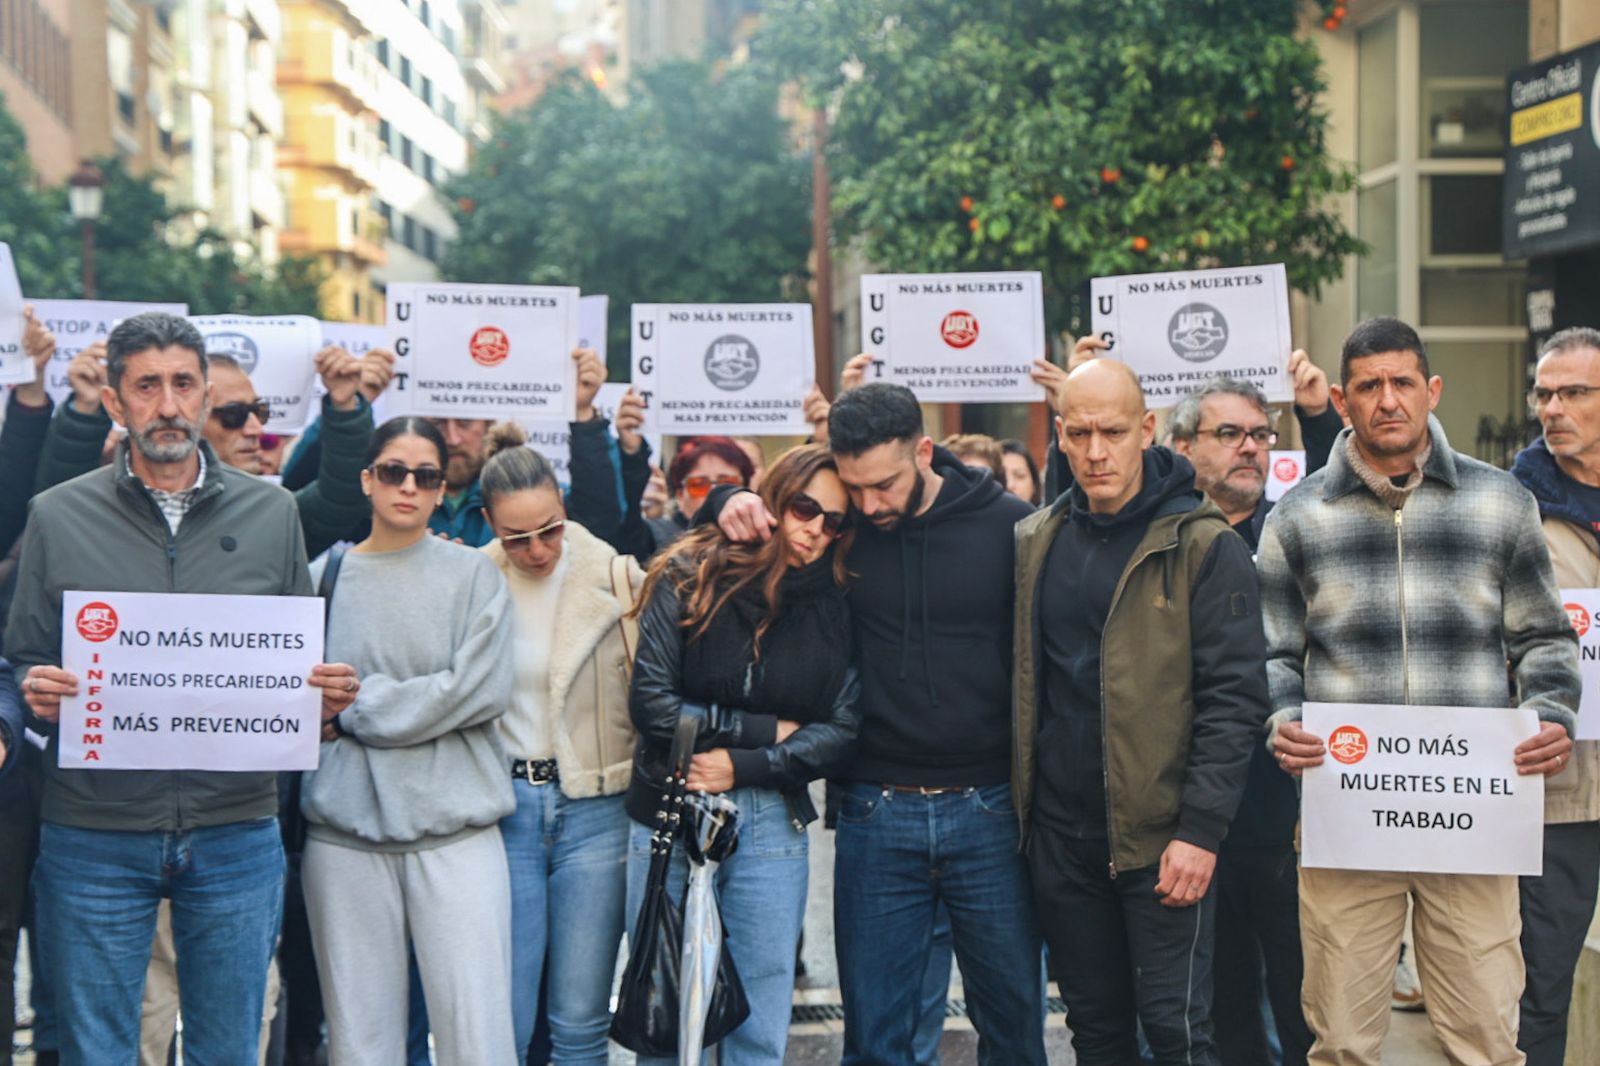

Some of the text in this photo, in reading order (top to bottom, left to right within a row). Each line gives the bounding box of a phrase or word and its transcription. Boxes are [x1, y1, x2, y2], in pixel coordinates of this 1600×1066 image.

[898, 281, 1024, 294] NO MÁS MUERTES
[1128, 273, 1264, 294] NO MÁS MUERTES
[426, 293, 558, 308] NO MÁS MUERTES
[668, 310, 794, 323] NO MÁS MUERTES
[1096, 294, 1115, 351] UG
[45, 319, 90, 334] STOP
[893, 364, 1032, 376] MENOS PRECARIEDAD
[417, 379, 563, 393] MENOS PRECARIEDAD
[907, 377, 1019, 388] MÁS PREVENCIÓN
[1139, 373, 1174, 384] ENOS
[430, 393, 548, 406] MÁS PREVENCIÓN
[661, 399, 801, 410] MENOS PRECARIEDAD
[704, 412, 788, 423] PREVENCIÓN
[118, 627, 305, 650] NO MÁS MUERTES
[110, 672, 302, 690] MENOS PRECARIEDAD
[82, 652, 103, 761] INFORMA
[112, 713, 300, 734] MÁS PREVENCIÓN
[1377, 734, 1469, 757] NO MÁS
[1340, 772, 1514, 796] MUERTES EN EL
[1371, 809, 1474, 831] TRABAJO
